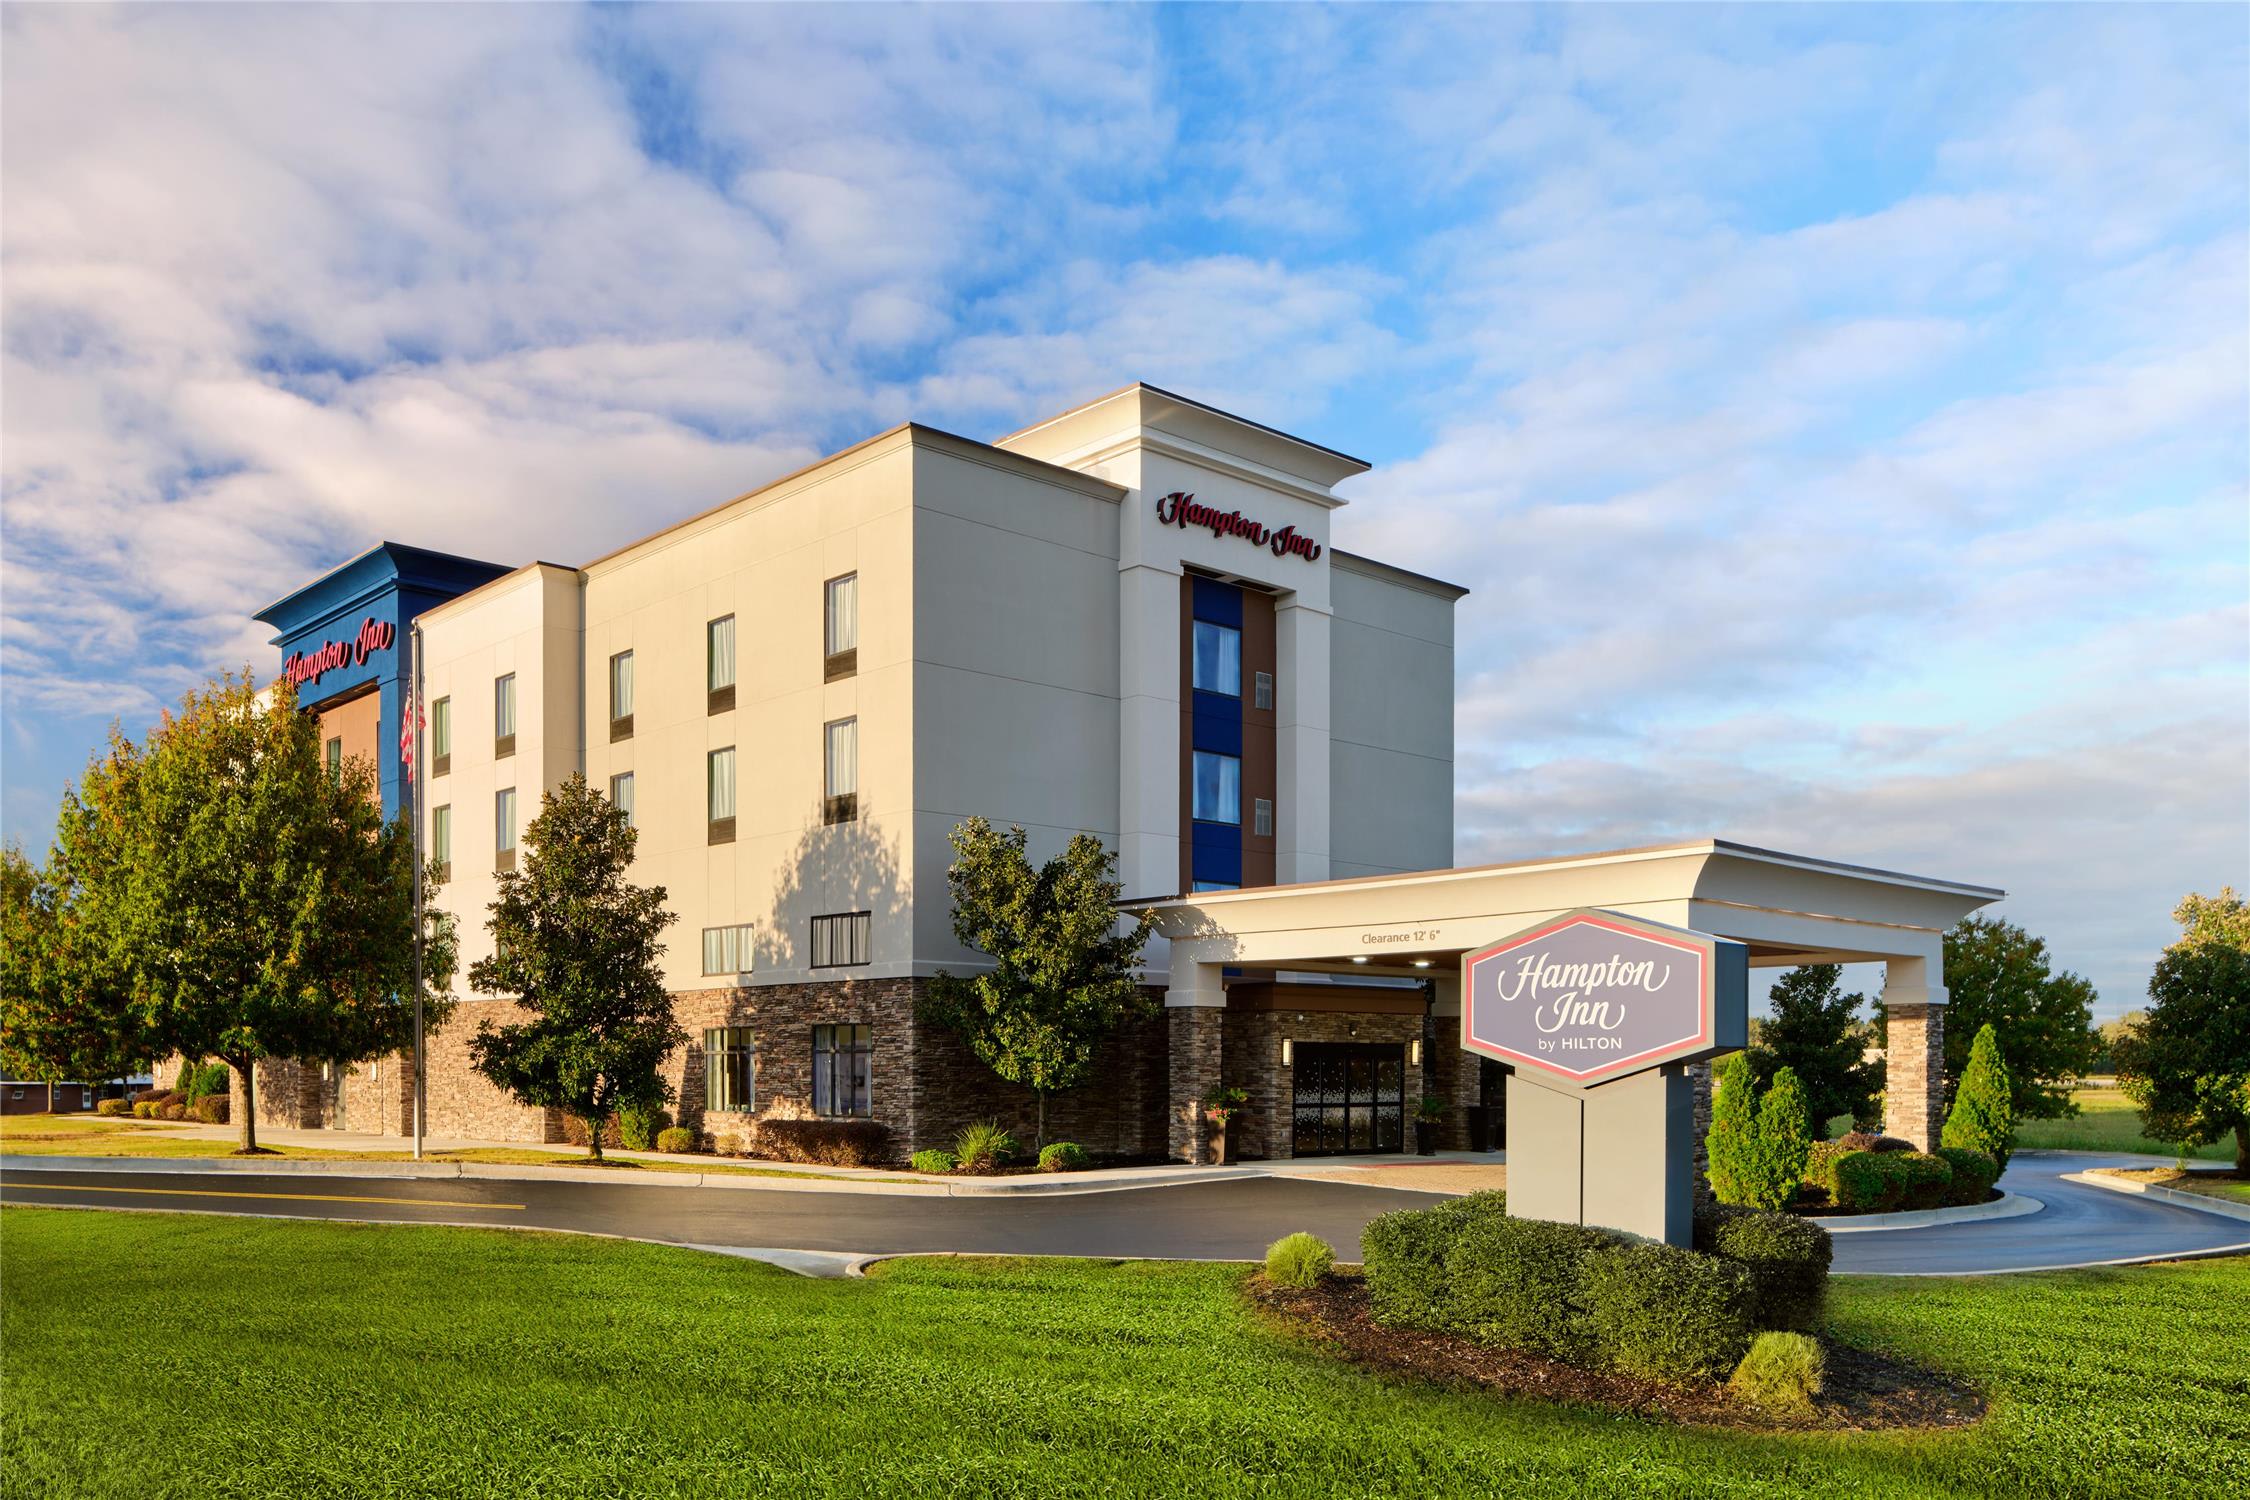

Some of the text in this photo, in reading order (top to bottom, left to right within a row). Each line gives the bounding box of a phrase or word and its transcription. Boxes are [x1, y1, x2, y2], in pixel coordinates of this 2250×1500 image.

[1156, 491, 1322, 563] Hampton Inn
[280, 616, 396, 689] Hampton Inn
[1361, 932, 1410, 944] Clearance
[1497, 951, 1670, 1001] Hampton
[1535, 991, 1626, 1033] Inn
[1538, 1037, 1623, 1052] by HILTON
